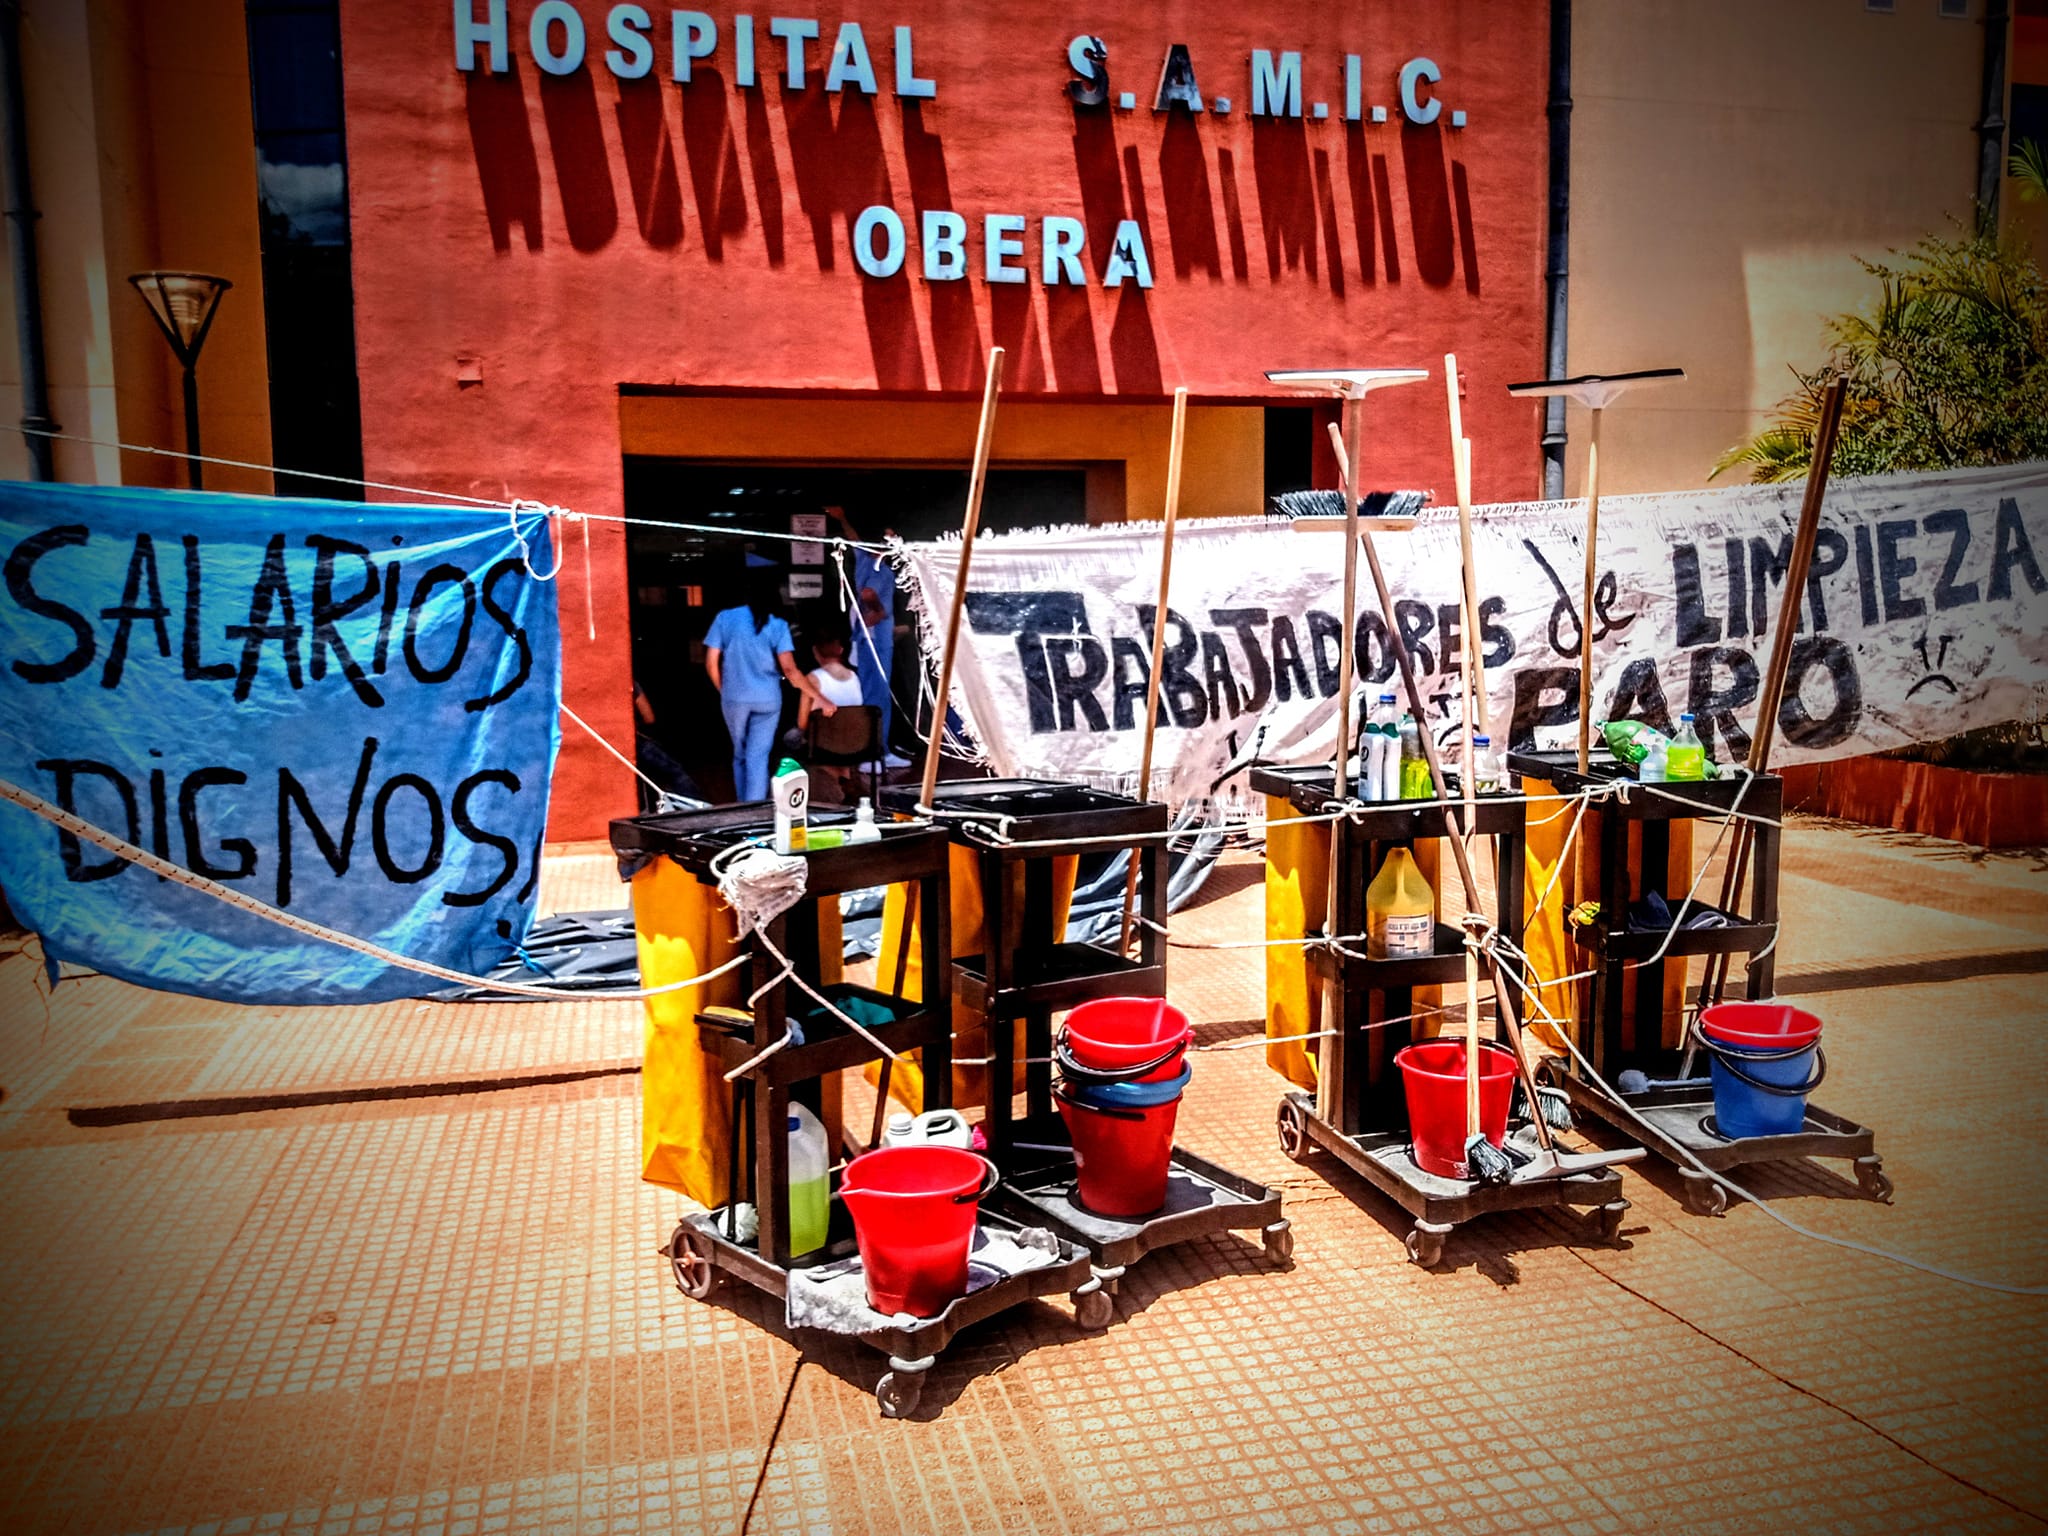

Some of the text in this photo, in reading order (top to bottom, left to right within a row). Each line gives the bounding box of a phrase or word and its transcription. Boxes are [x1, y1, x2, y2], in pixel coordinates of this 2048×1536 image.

[453, 0, 937, 97] HOSPITAL
[853, 205, 1154, 288] OBERA
[964, 497, 2048, 734] TRABAJADORES de LIMPIEZA
[1508, 636, 1862, 765] PARO
